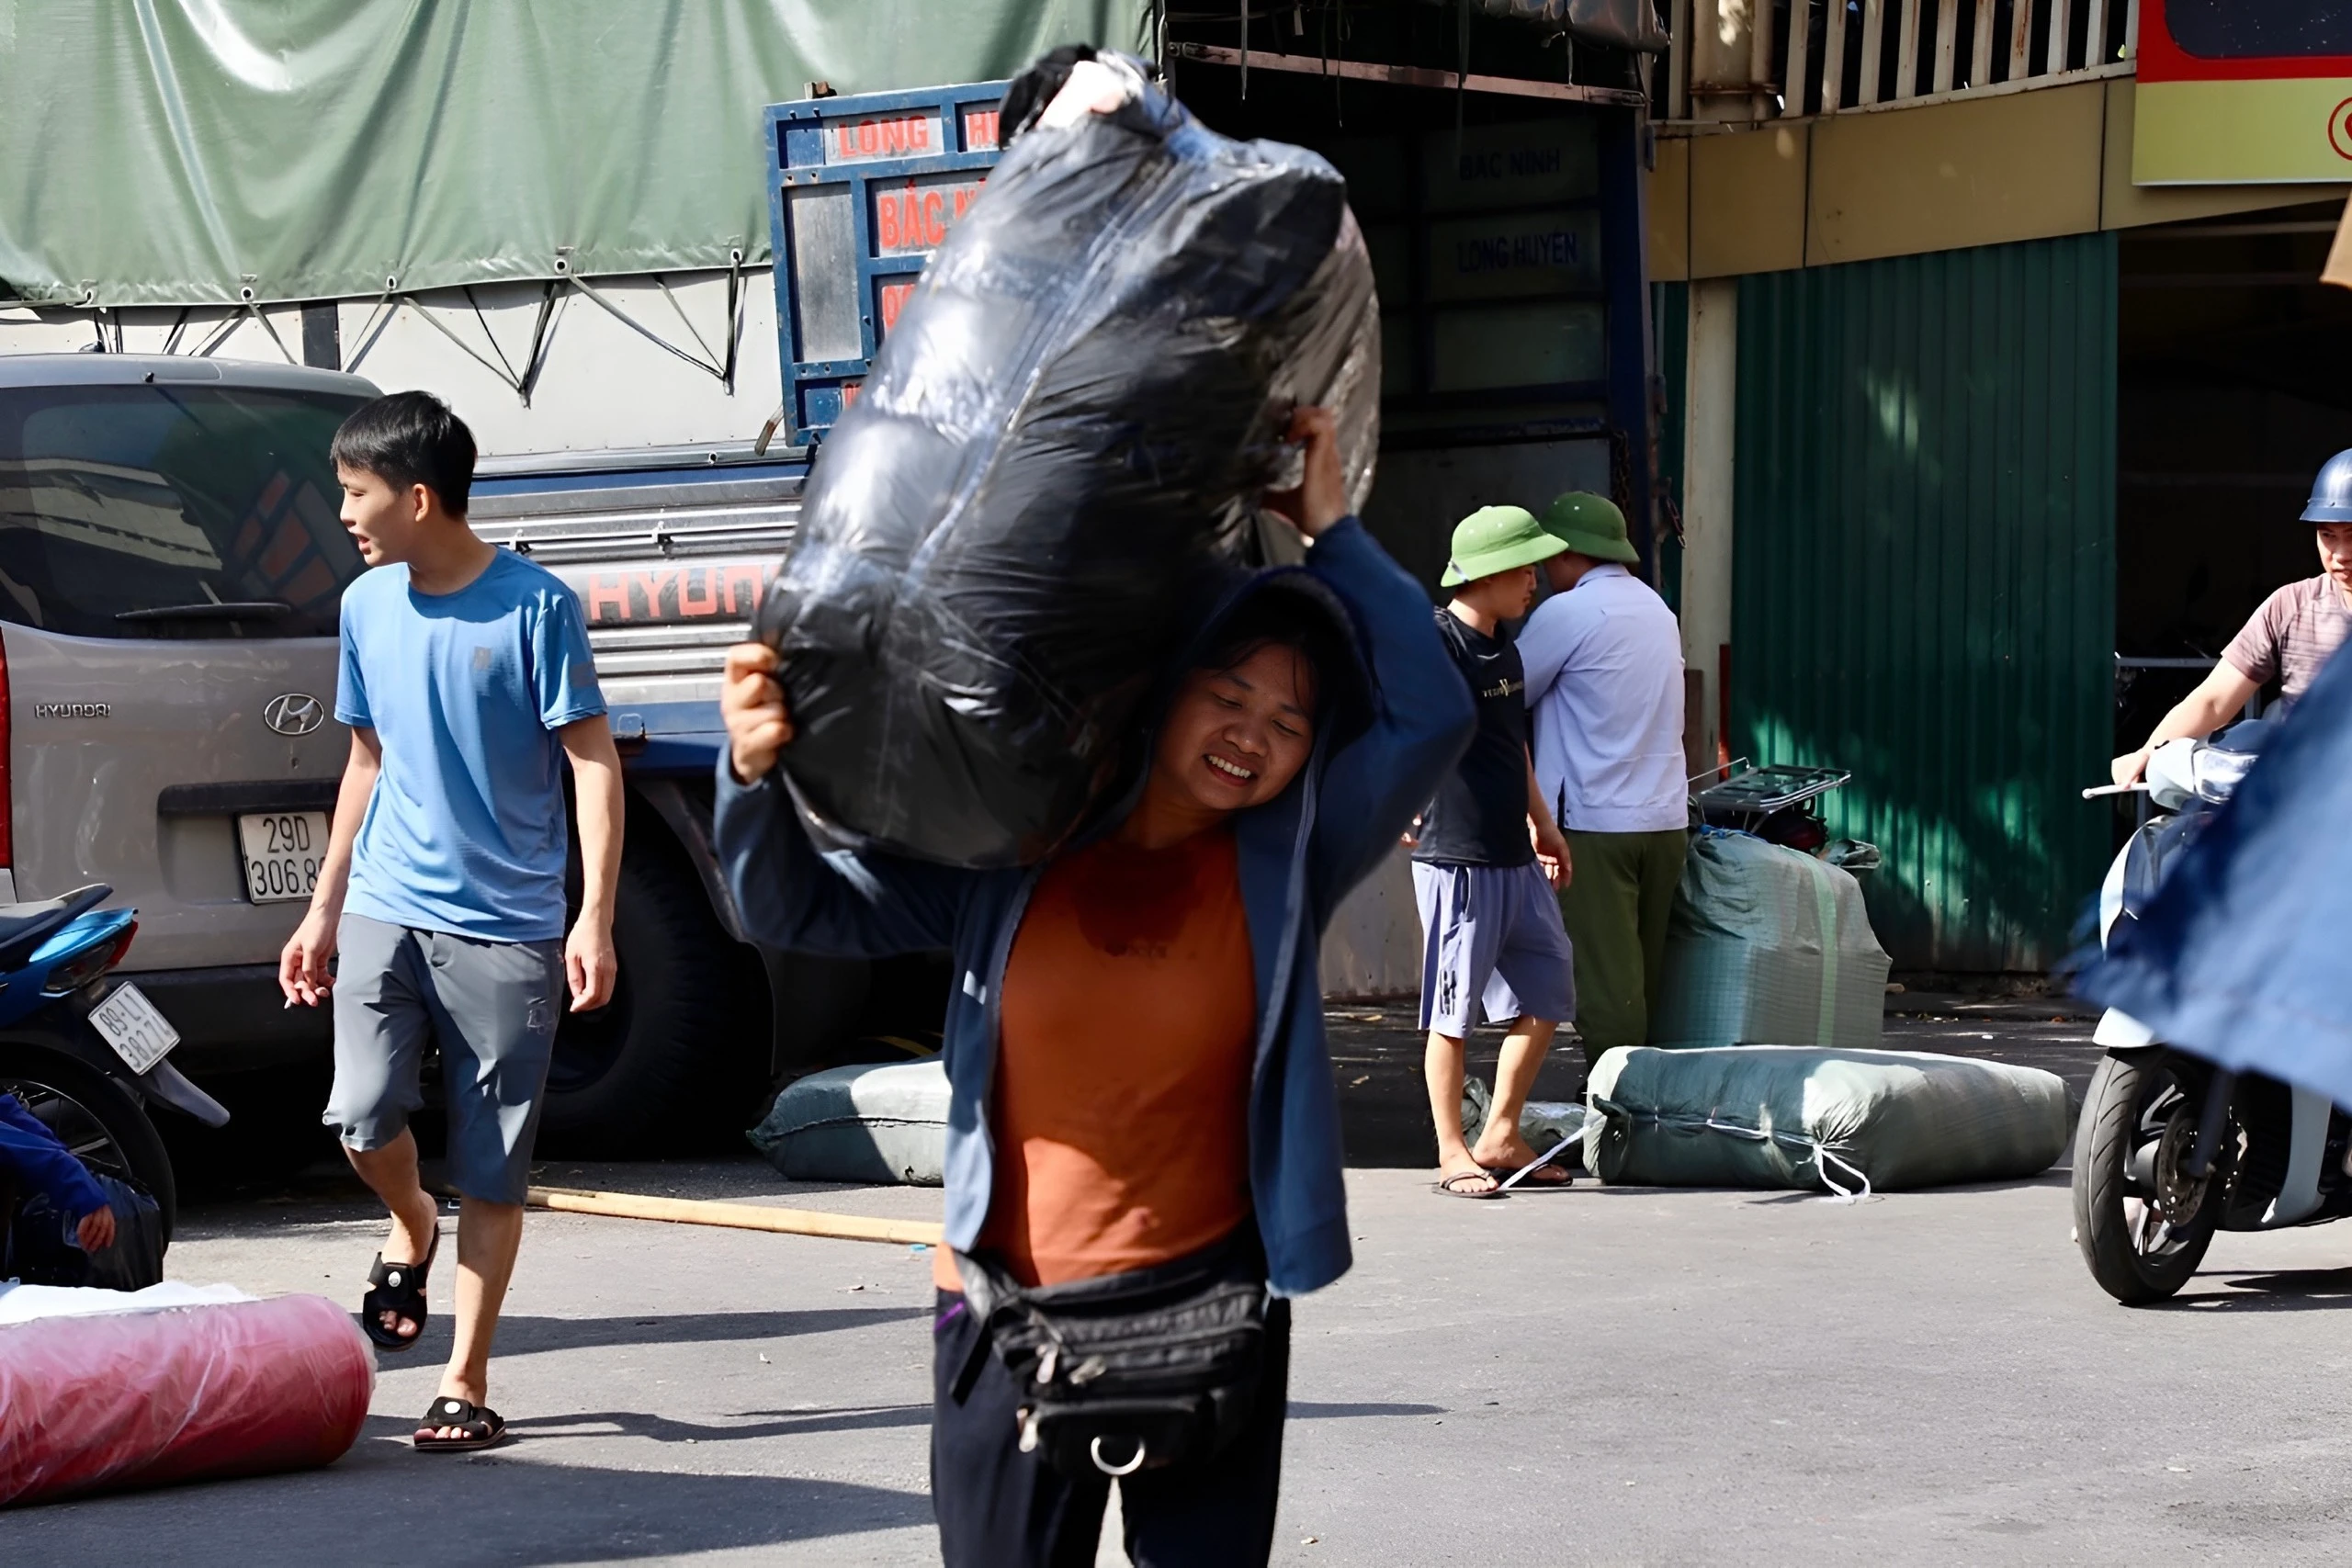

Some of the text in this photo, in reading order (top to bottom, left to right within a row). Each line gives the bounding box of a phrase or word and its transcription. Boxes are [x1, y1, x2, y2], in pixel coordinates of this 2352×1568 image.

[838, 115, 930, 158] LONG
[1456, 235, 1510, 274] LONG
[587, 564, 781, 621] HYUN
[34, 703, 111, 718] HYUNDAI
[263, 816, 311, 854] 29D
